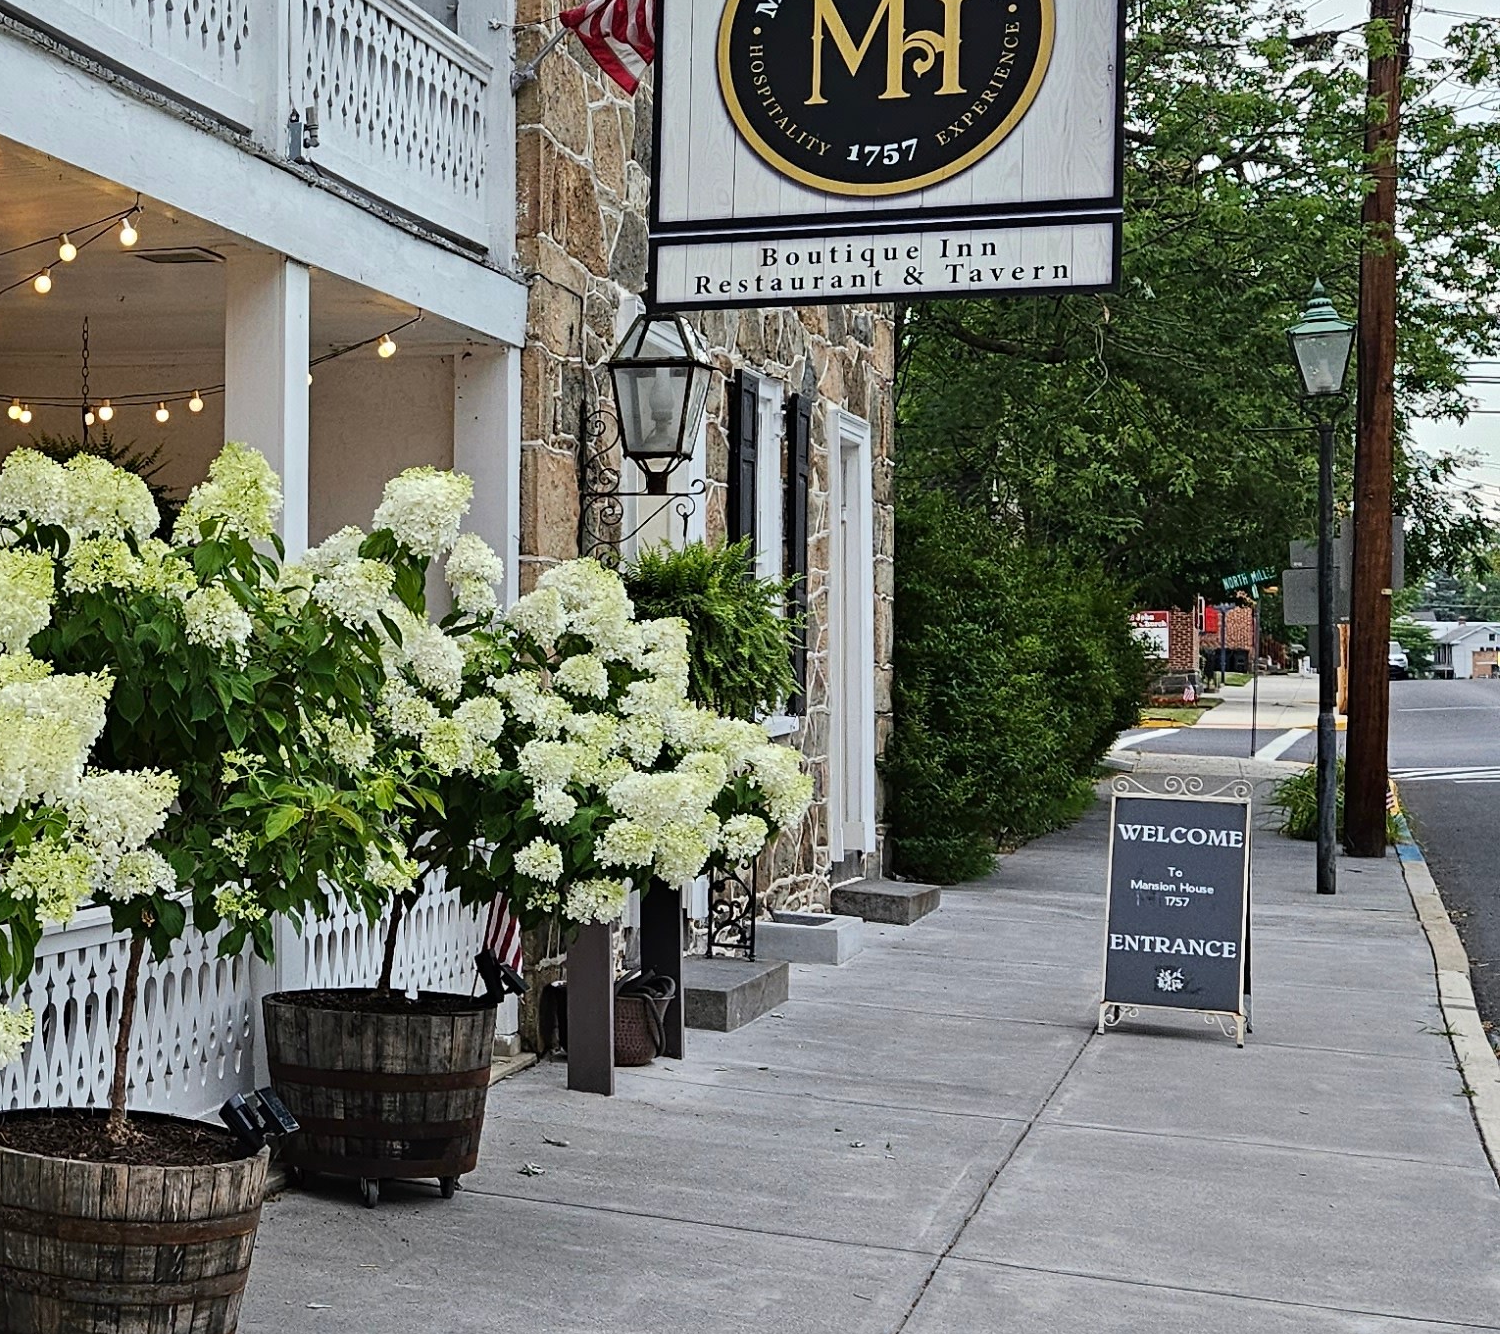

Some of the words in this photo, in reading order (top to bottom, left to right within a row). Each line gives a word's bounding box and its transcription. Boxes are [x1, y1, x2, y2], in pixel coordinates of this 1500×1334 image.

[935, 22, 1019, 145] EXPERIENCE
[750, 45, 831, 155] HOSPITALITY
[847, 139, 917, 166] 1757
[761, 244, 918, 267] Boutique
[940, 239, 996, 258] Inn
[695, 270, 882, 294] Restaurant
[904, 266, 924, 285] &
[945, 262, 1070, 284] Tavern
[1222, 573, 1249, 590] NORTH
[1118, 824, 1243, 848] WELCOME
[1168, 867, 1182, 877] To
[1131, 880, 1176, 891] Mansion
[1180, 883, 1214, 894] House
[1165, 896, 1189, 906] 1757
[1110, 934, 1236, 958] ENTRANCE
